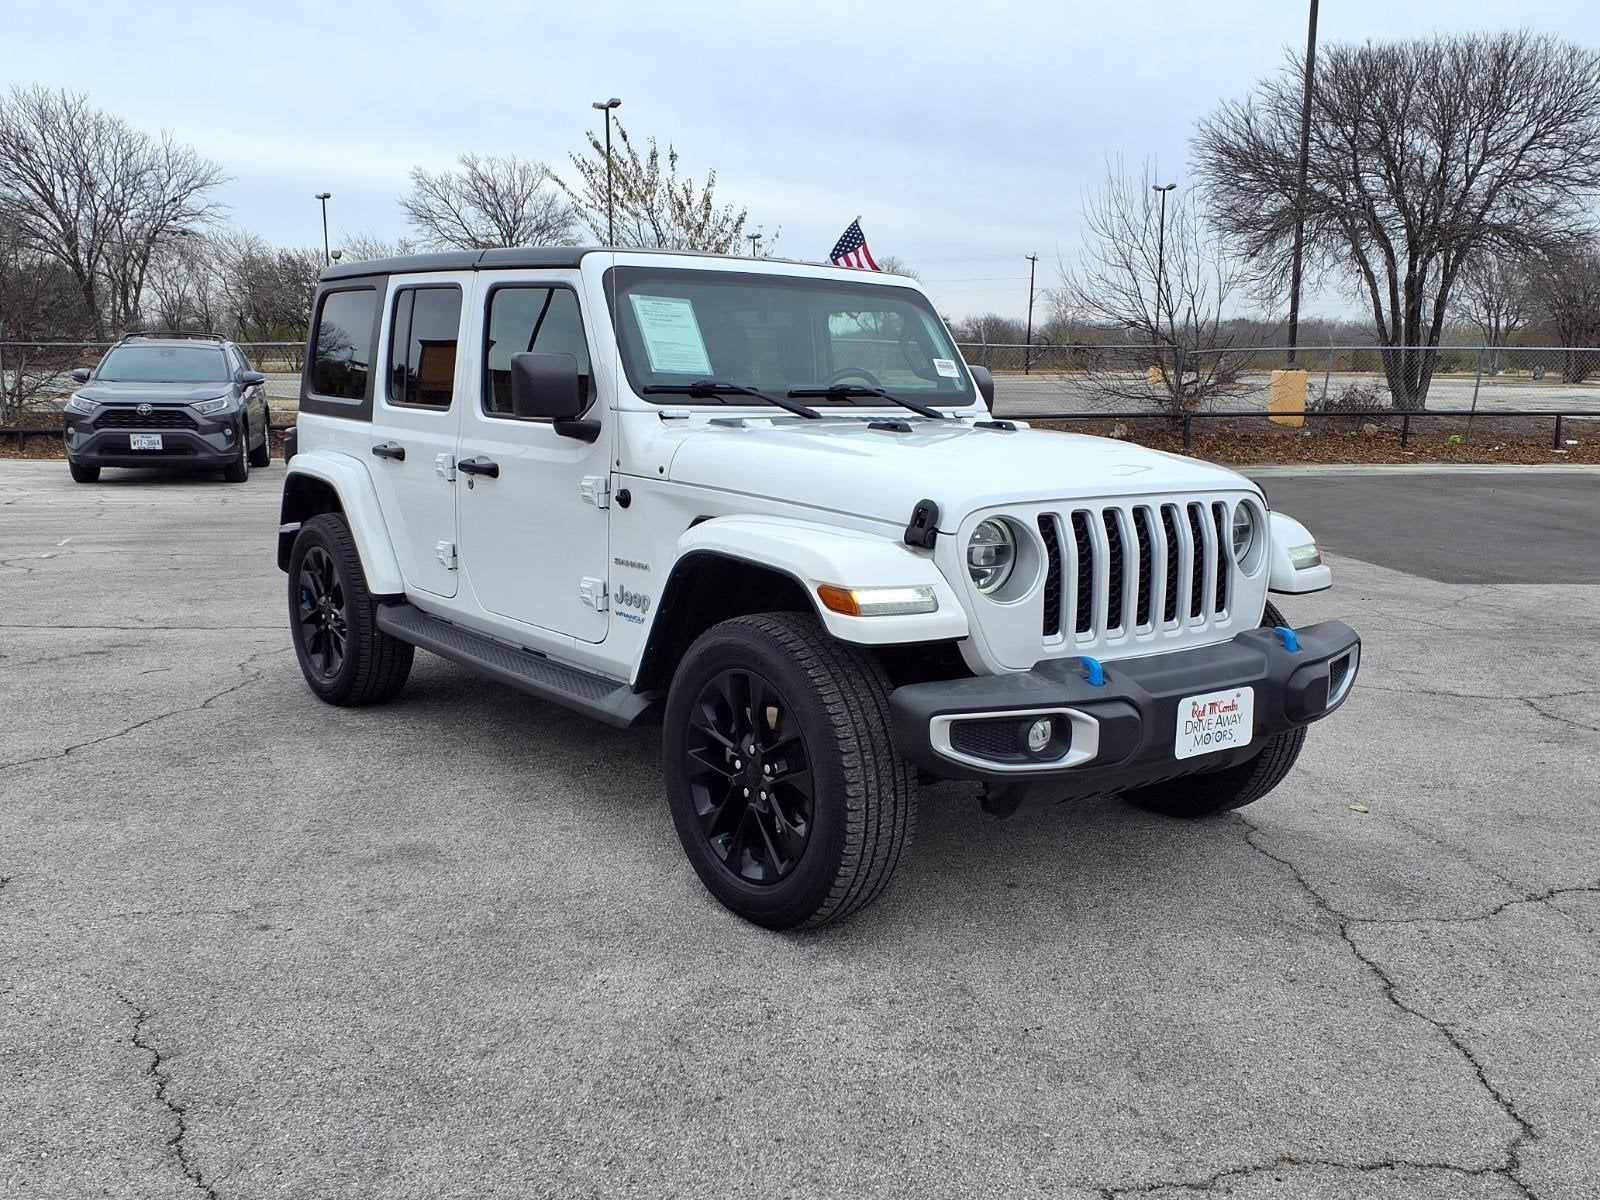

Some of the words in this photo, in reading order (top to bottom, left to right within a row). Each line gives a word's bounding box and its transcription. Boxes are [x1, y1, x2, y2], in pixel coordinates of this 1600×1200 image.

[614, 584, 651, 614] Jeep
[1192, 703, 1207, 721] Red
[1185, 718, 1213, 735] DRIVE
[1214, 712, 1243, 729] AWAY
[1193, 728, 1234, 747] MOTORS
